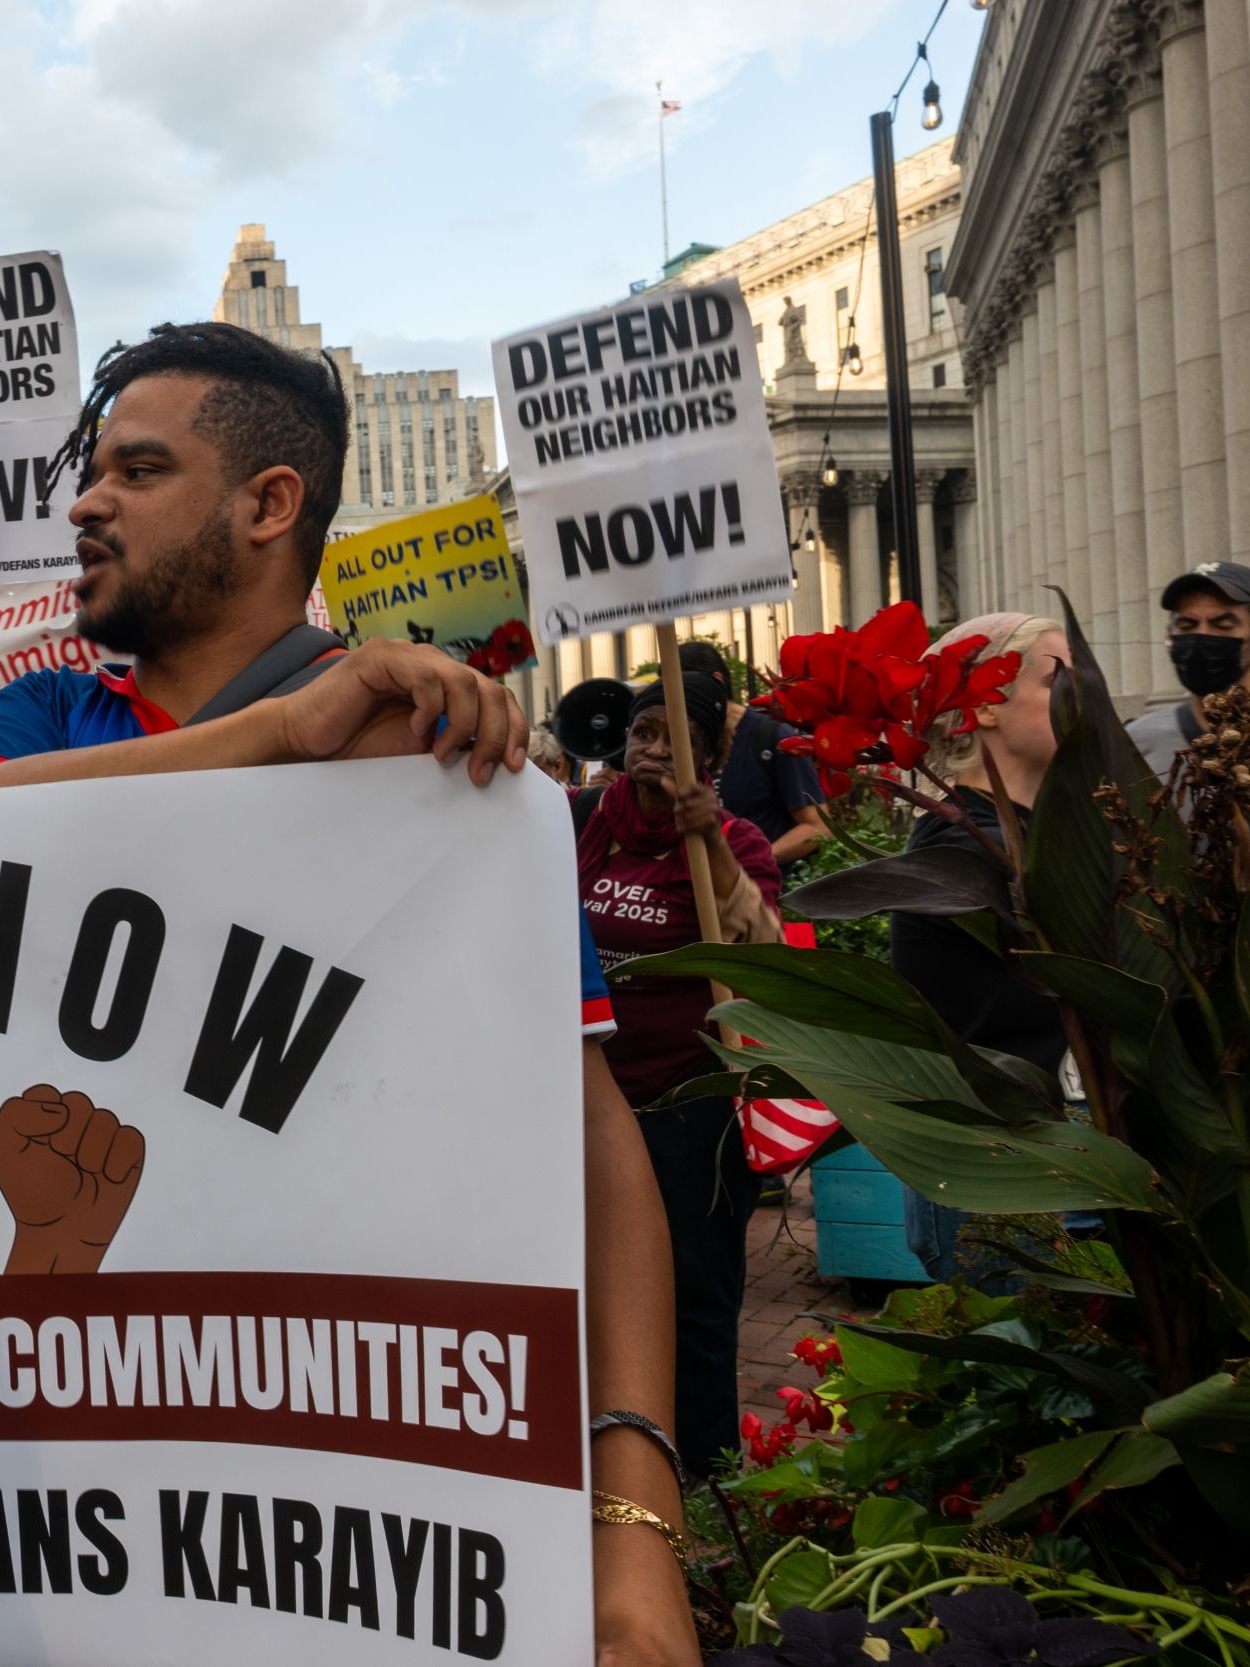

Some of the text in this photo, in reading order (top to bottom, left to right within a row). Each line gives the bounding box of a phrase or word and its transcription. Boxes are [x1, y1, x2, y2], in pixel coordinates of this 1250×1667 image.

[507, 293, 735, 392] DEFEND
[517, 348, 742, 431] OUR HAITIAN
[534, 390, 737, 467] NEIGHBORS
[336, 556, 366, 583] ALL
[371, 537, 424, 570] OUT
[434, 518, 497, 553] FOR
[556, 480, 746, 581] NOW!
[343, 578, 428, 620] HAITIAN
[614, 902, 668, 925] 2025
[158, 1488, 506, 1661] KARAYIB
